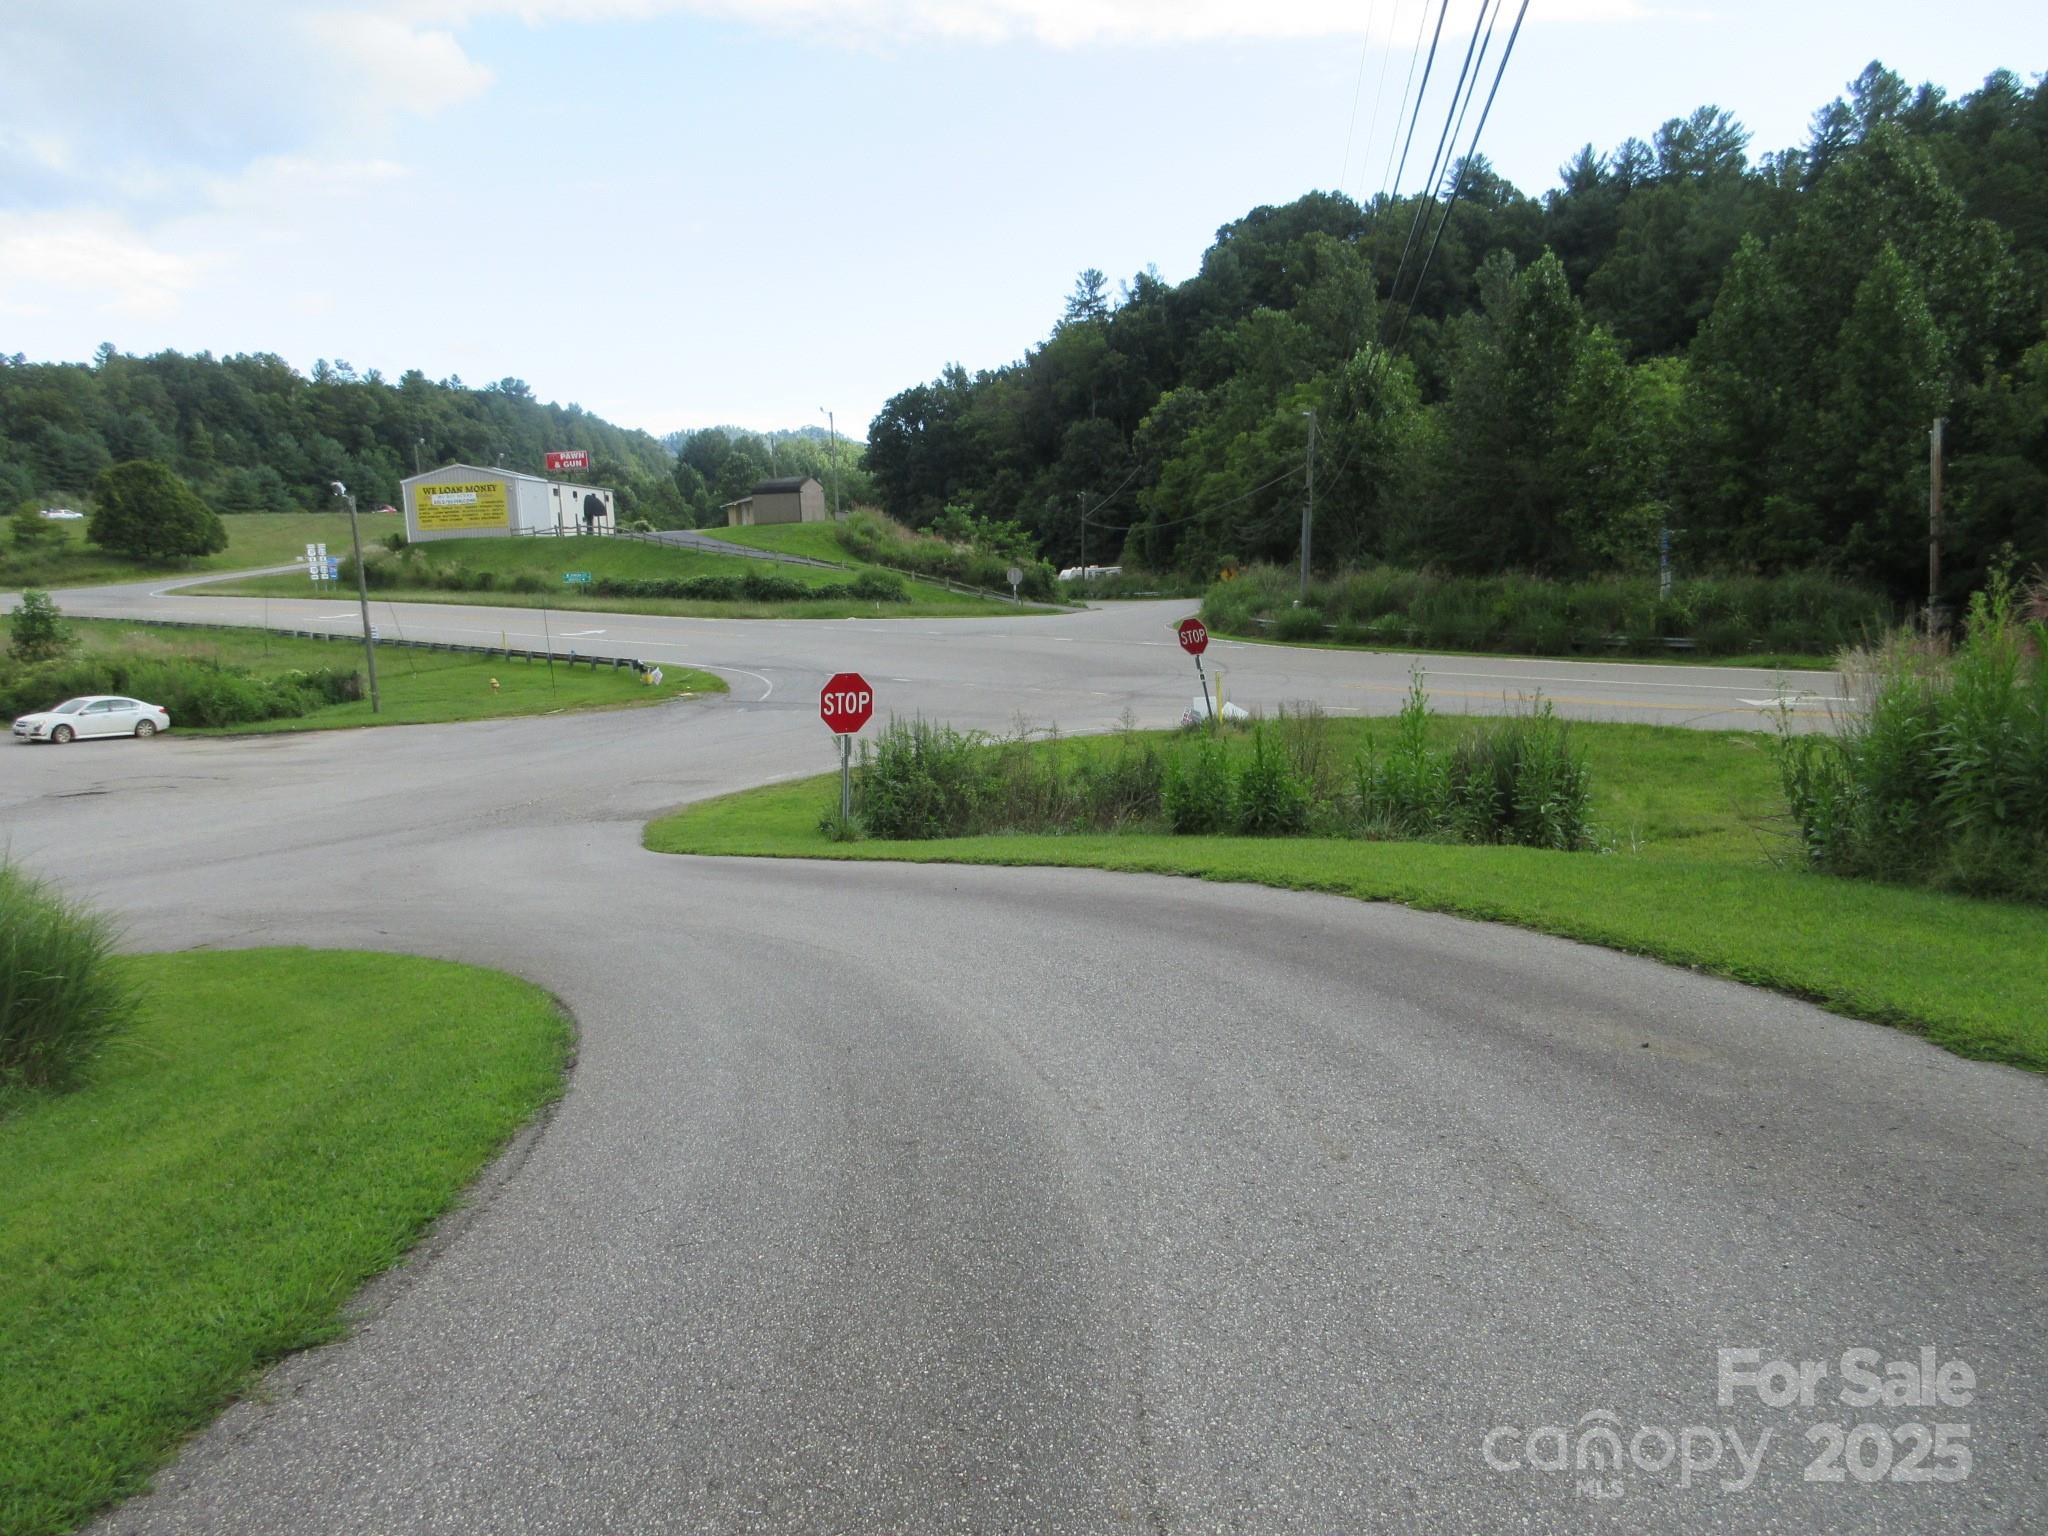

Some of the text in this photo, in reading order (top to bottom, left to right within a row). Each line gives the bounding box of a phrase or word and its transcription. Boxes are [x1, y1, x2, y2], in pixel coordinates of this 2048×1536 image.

[560, 452, 584, 460] PAWN
[563, 460, 582, 468] GUN
[422, 484, 497, 495] WE LOAN MONEY
[1180, 628, 1205, 645] STOP
[823, 691, 870, 715] STOP
